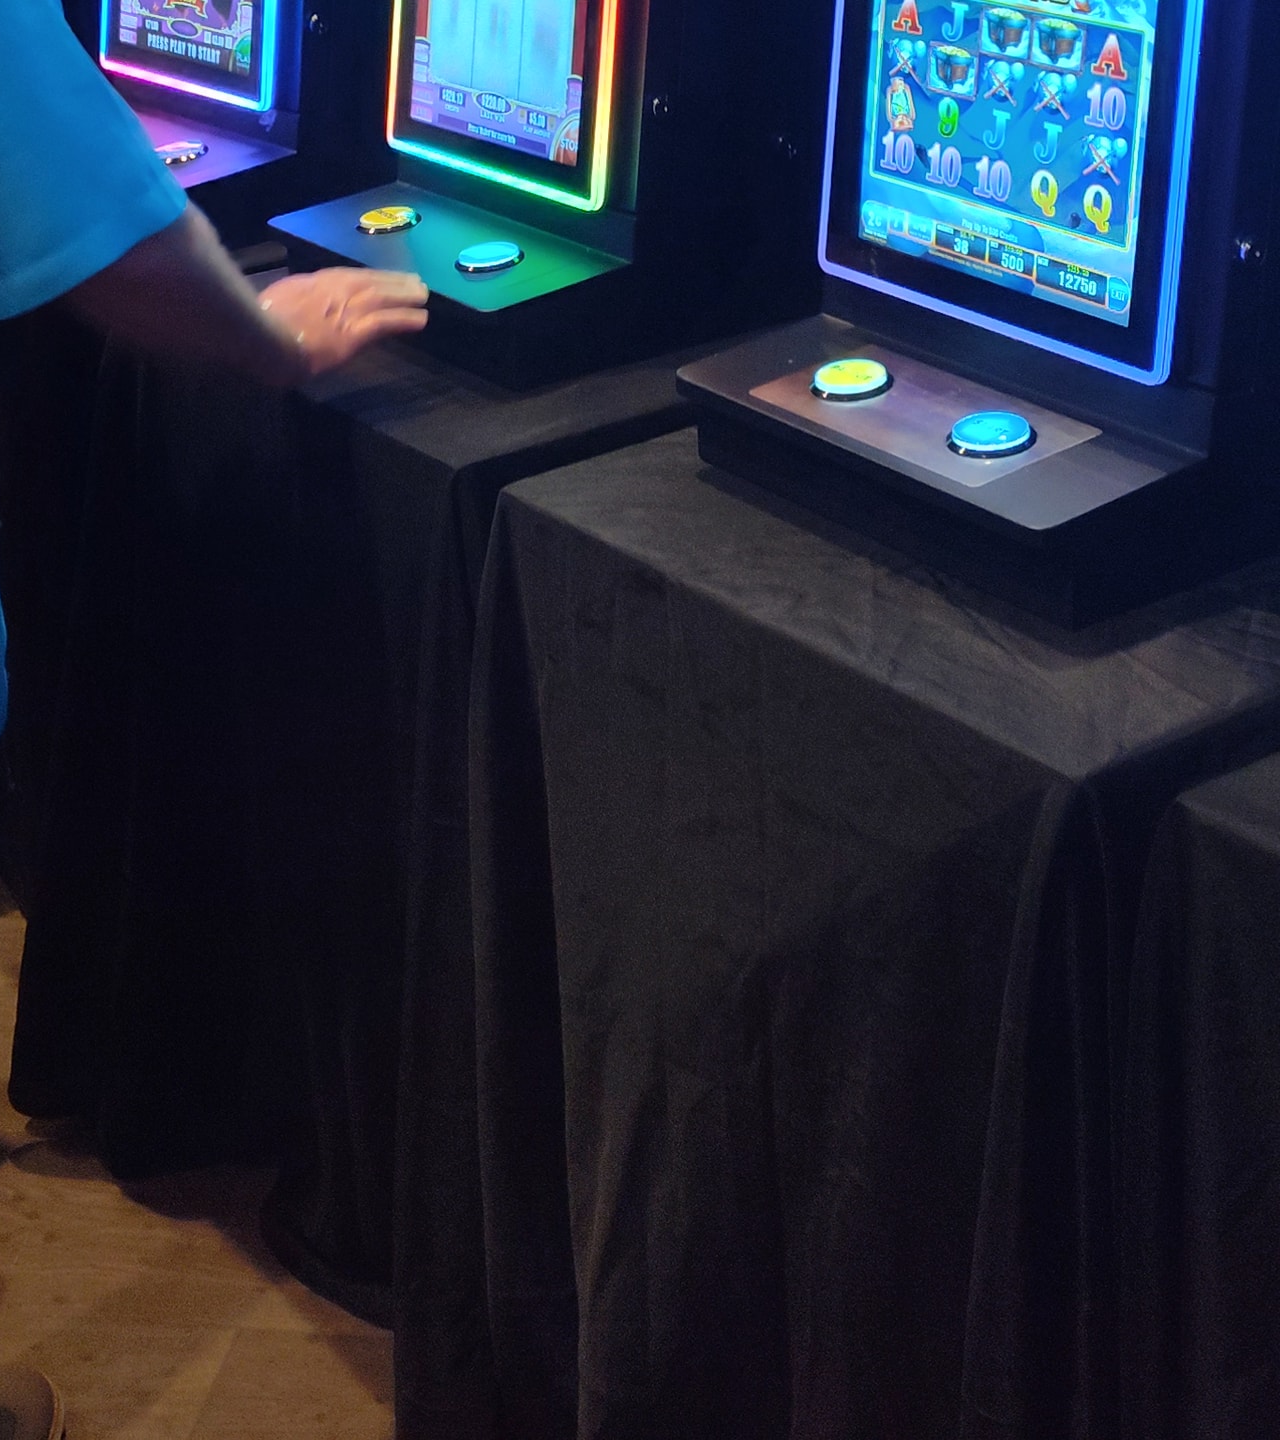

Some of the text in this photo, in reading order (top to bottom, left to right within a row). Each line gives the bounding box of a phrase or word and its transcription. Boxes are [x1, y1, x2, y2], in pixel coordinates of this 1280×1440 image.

[940, 1, 969, 42] J
[147, 32, 169, 52] PRESS
[169, 38, 186, 56] PLAY
[187, 42, 197, 60] TO
[198, 46, 220, 64] START
[1092, 33, 1127, 80] A
[938, 96, 960, 138] 9
[1084, 82, 1126, 130] 10
[983, 108, 1012, 151] J
[1033, 122, 1064, 164] J
[880, 130, 915, 174] 10
[925, 142, 962, 187] 10
[972, 155, 1012, 203] 10
[1030, 169, 1058, 217] Q
[1082, 184, 1113, 232] Q
[953, 237, 969, 255] 38
[1001, 252, 1024, 273] 500
[1058, 270, 1097, 296] 12750
